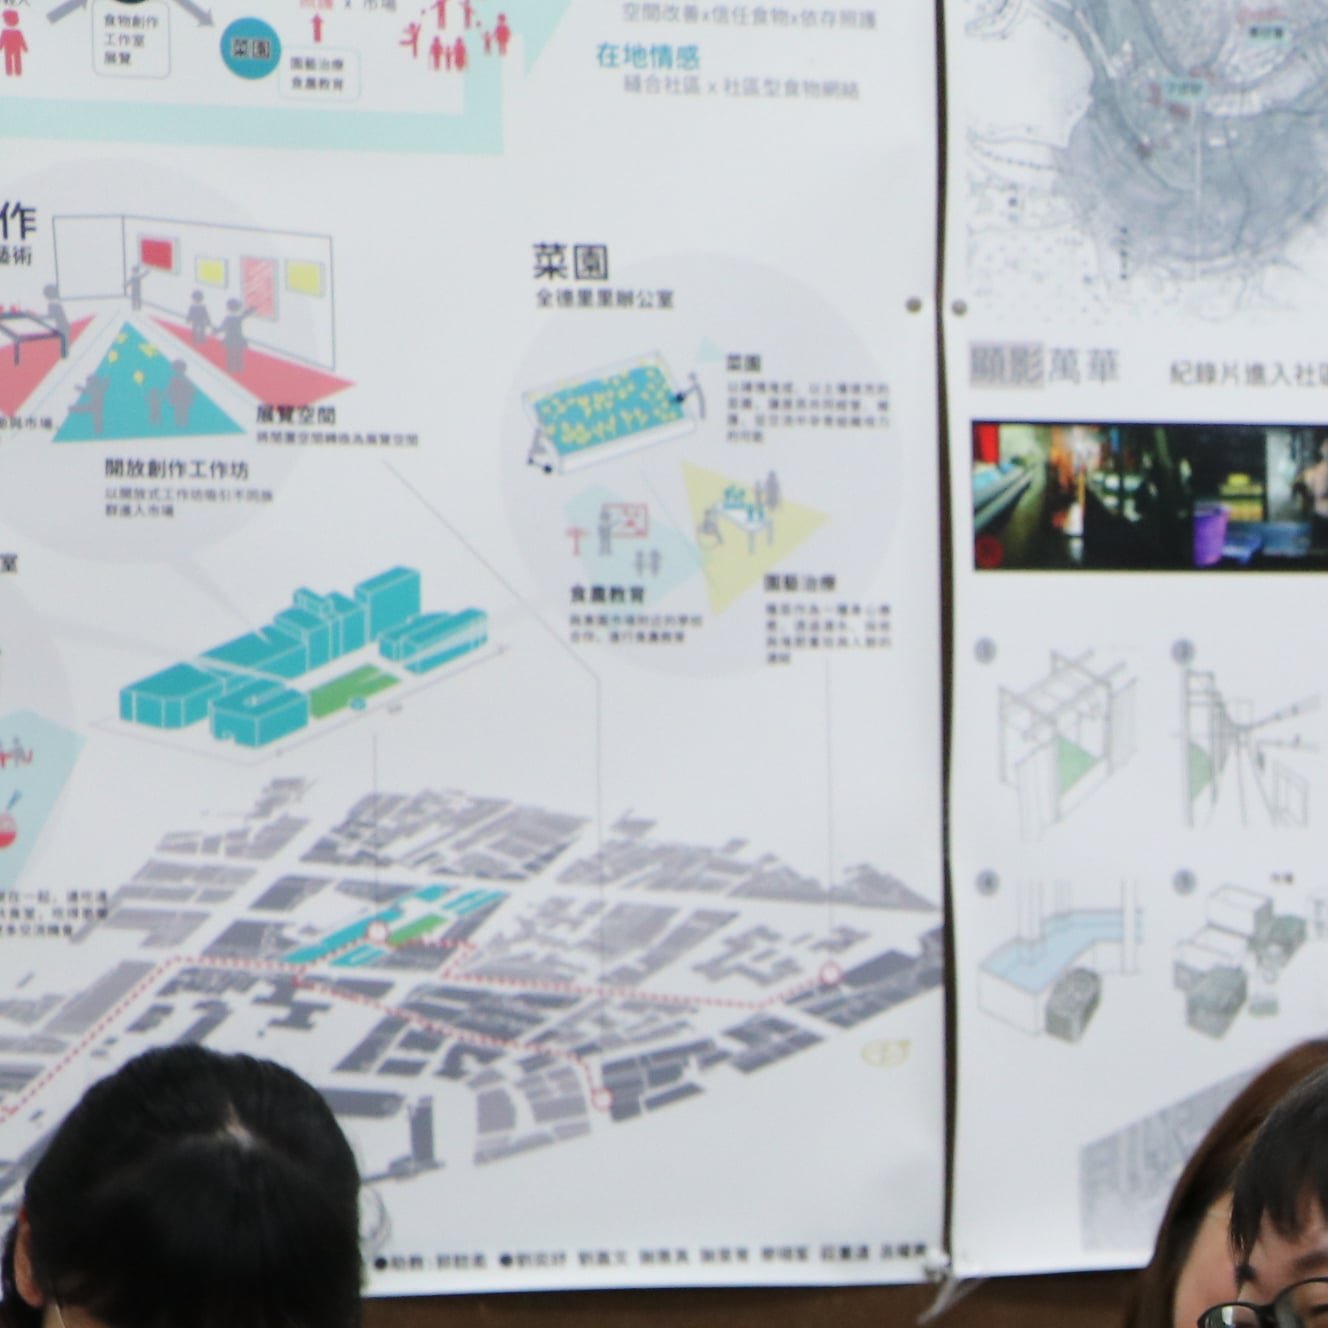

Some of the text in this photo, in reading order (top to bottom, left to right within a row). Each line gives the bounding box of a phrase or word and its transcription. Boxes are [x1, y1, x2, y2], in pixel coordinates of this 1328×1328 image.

[232, 39, 270, 59] 菜園
[596, 42, 700, 71] 在地情感
[534, 242, 609, 281] 菜園
[257, 405, 337, 427] 展覽空間
[105, 457, 249, 481] 開放創作工作坊
